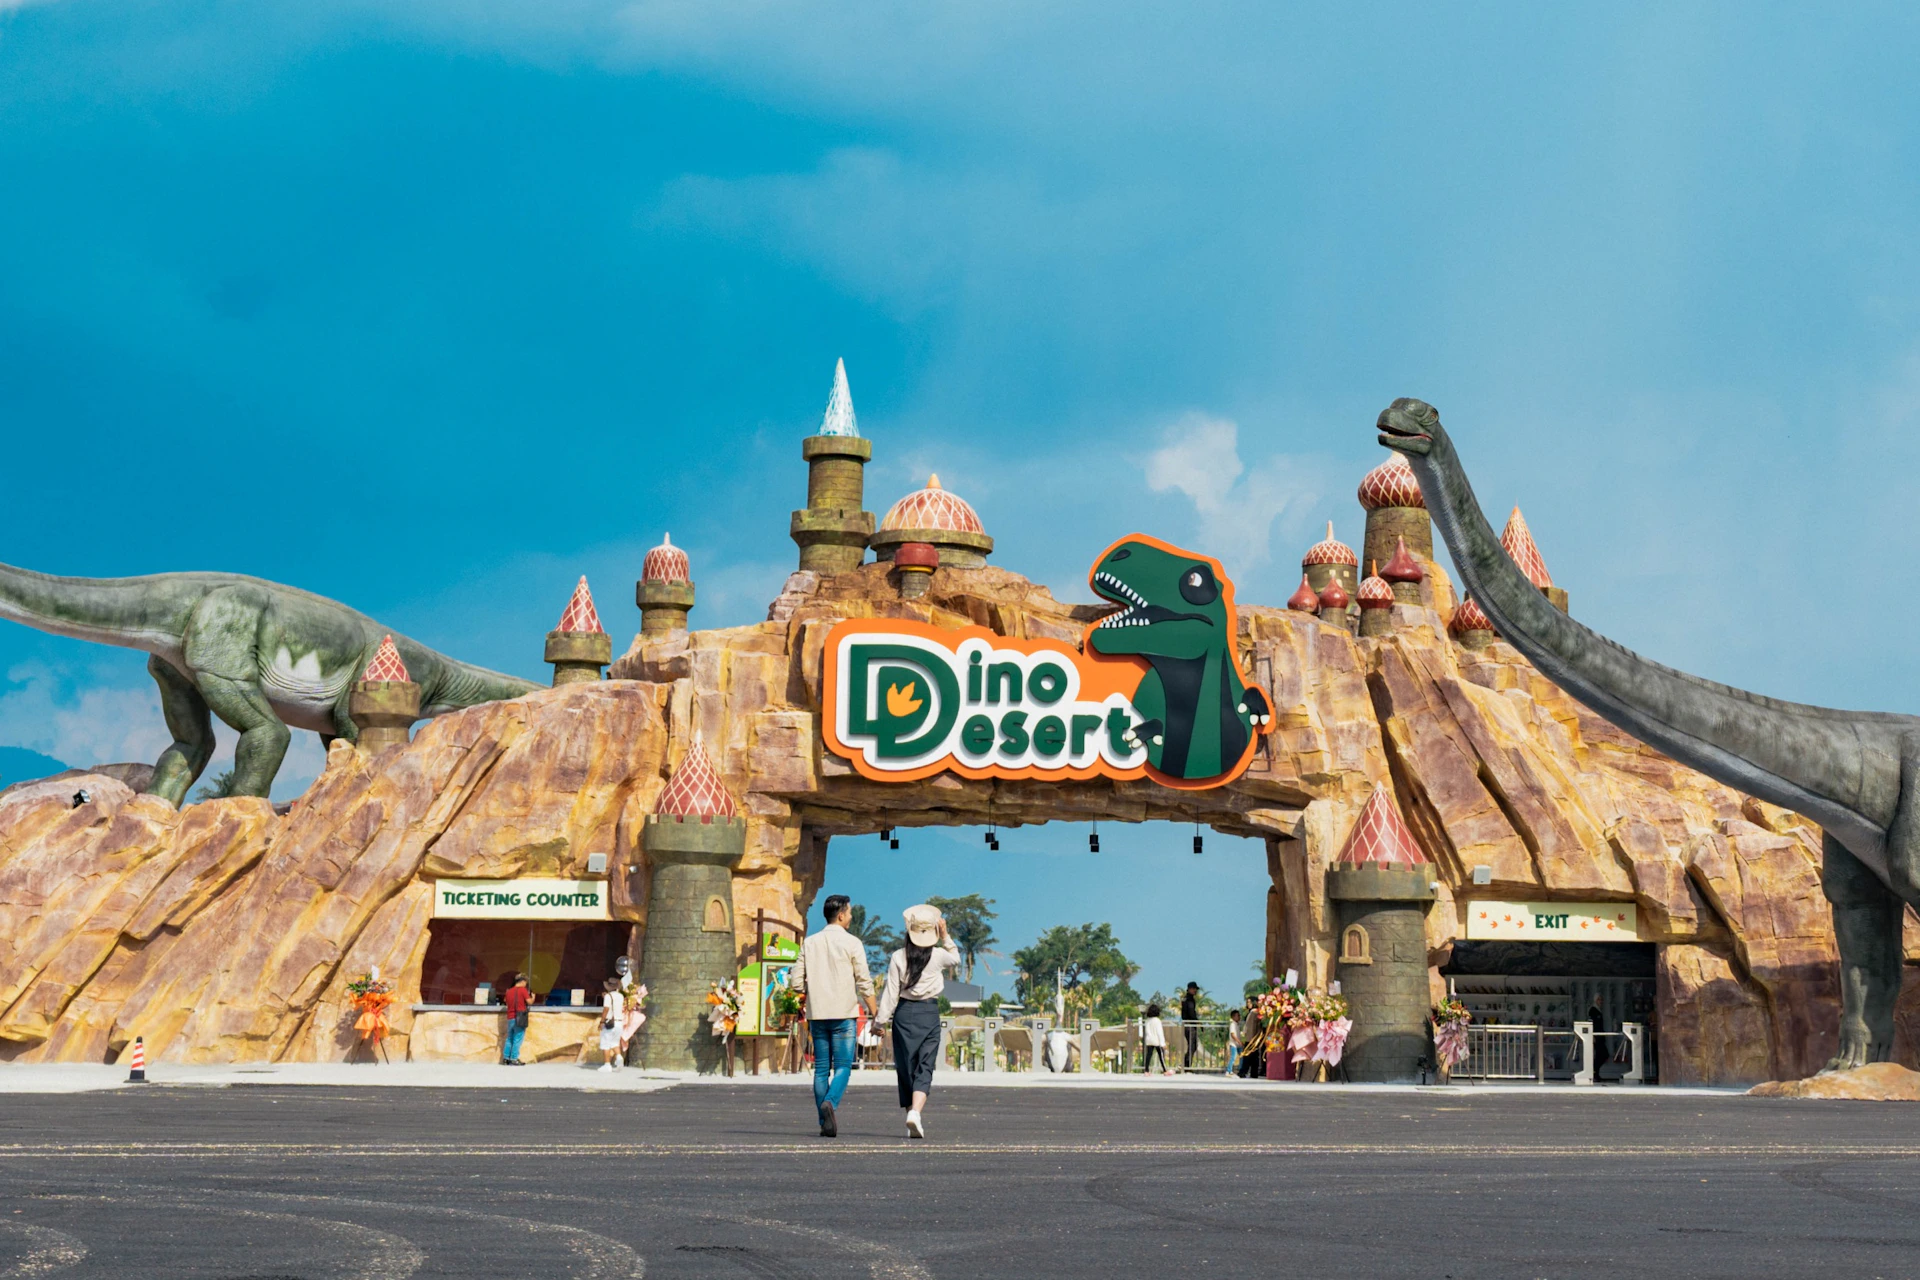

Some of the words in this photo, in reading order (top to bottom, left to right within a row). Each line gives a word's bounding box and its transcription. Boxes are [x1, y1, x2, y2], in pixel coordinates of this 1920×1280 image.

[850, 644, 1067, 735] Dino
[443, 892, 521, 906] TICKETING
[526, 893, 599, 907] COUNTER
[1536, 914, 1569, 928] EXIT
